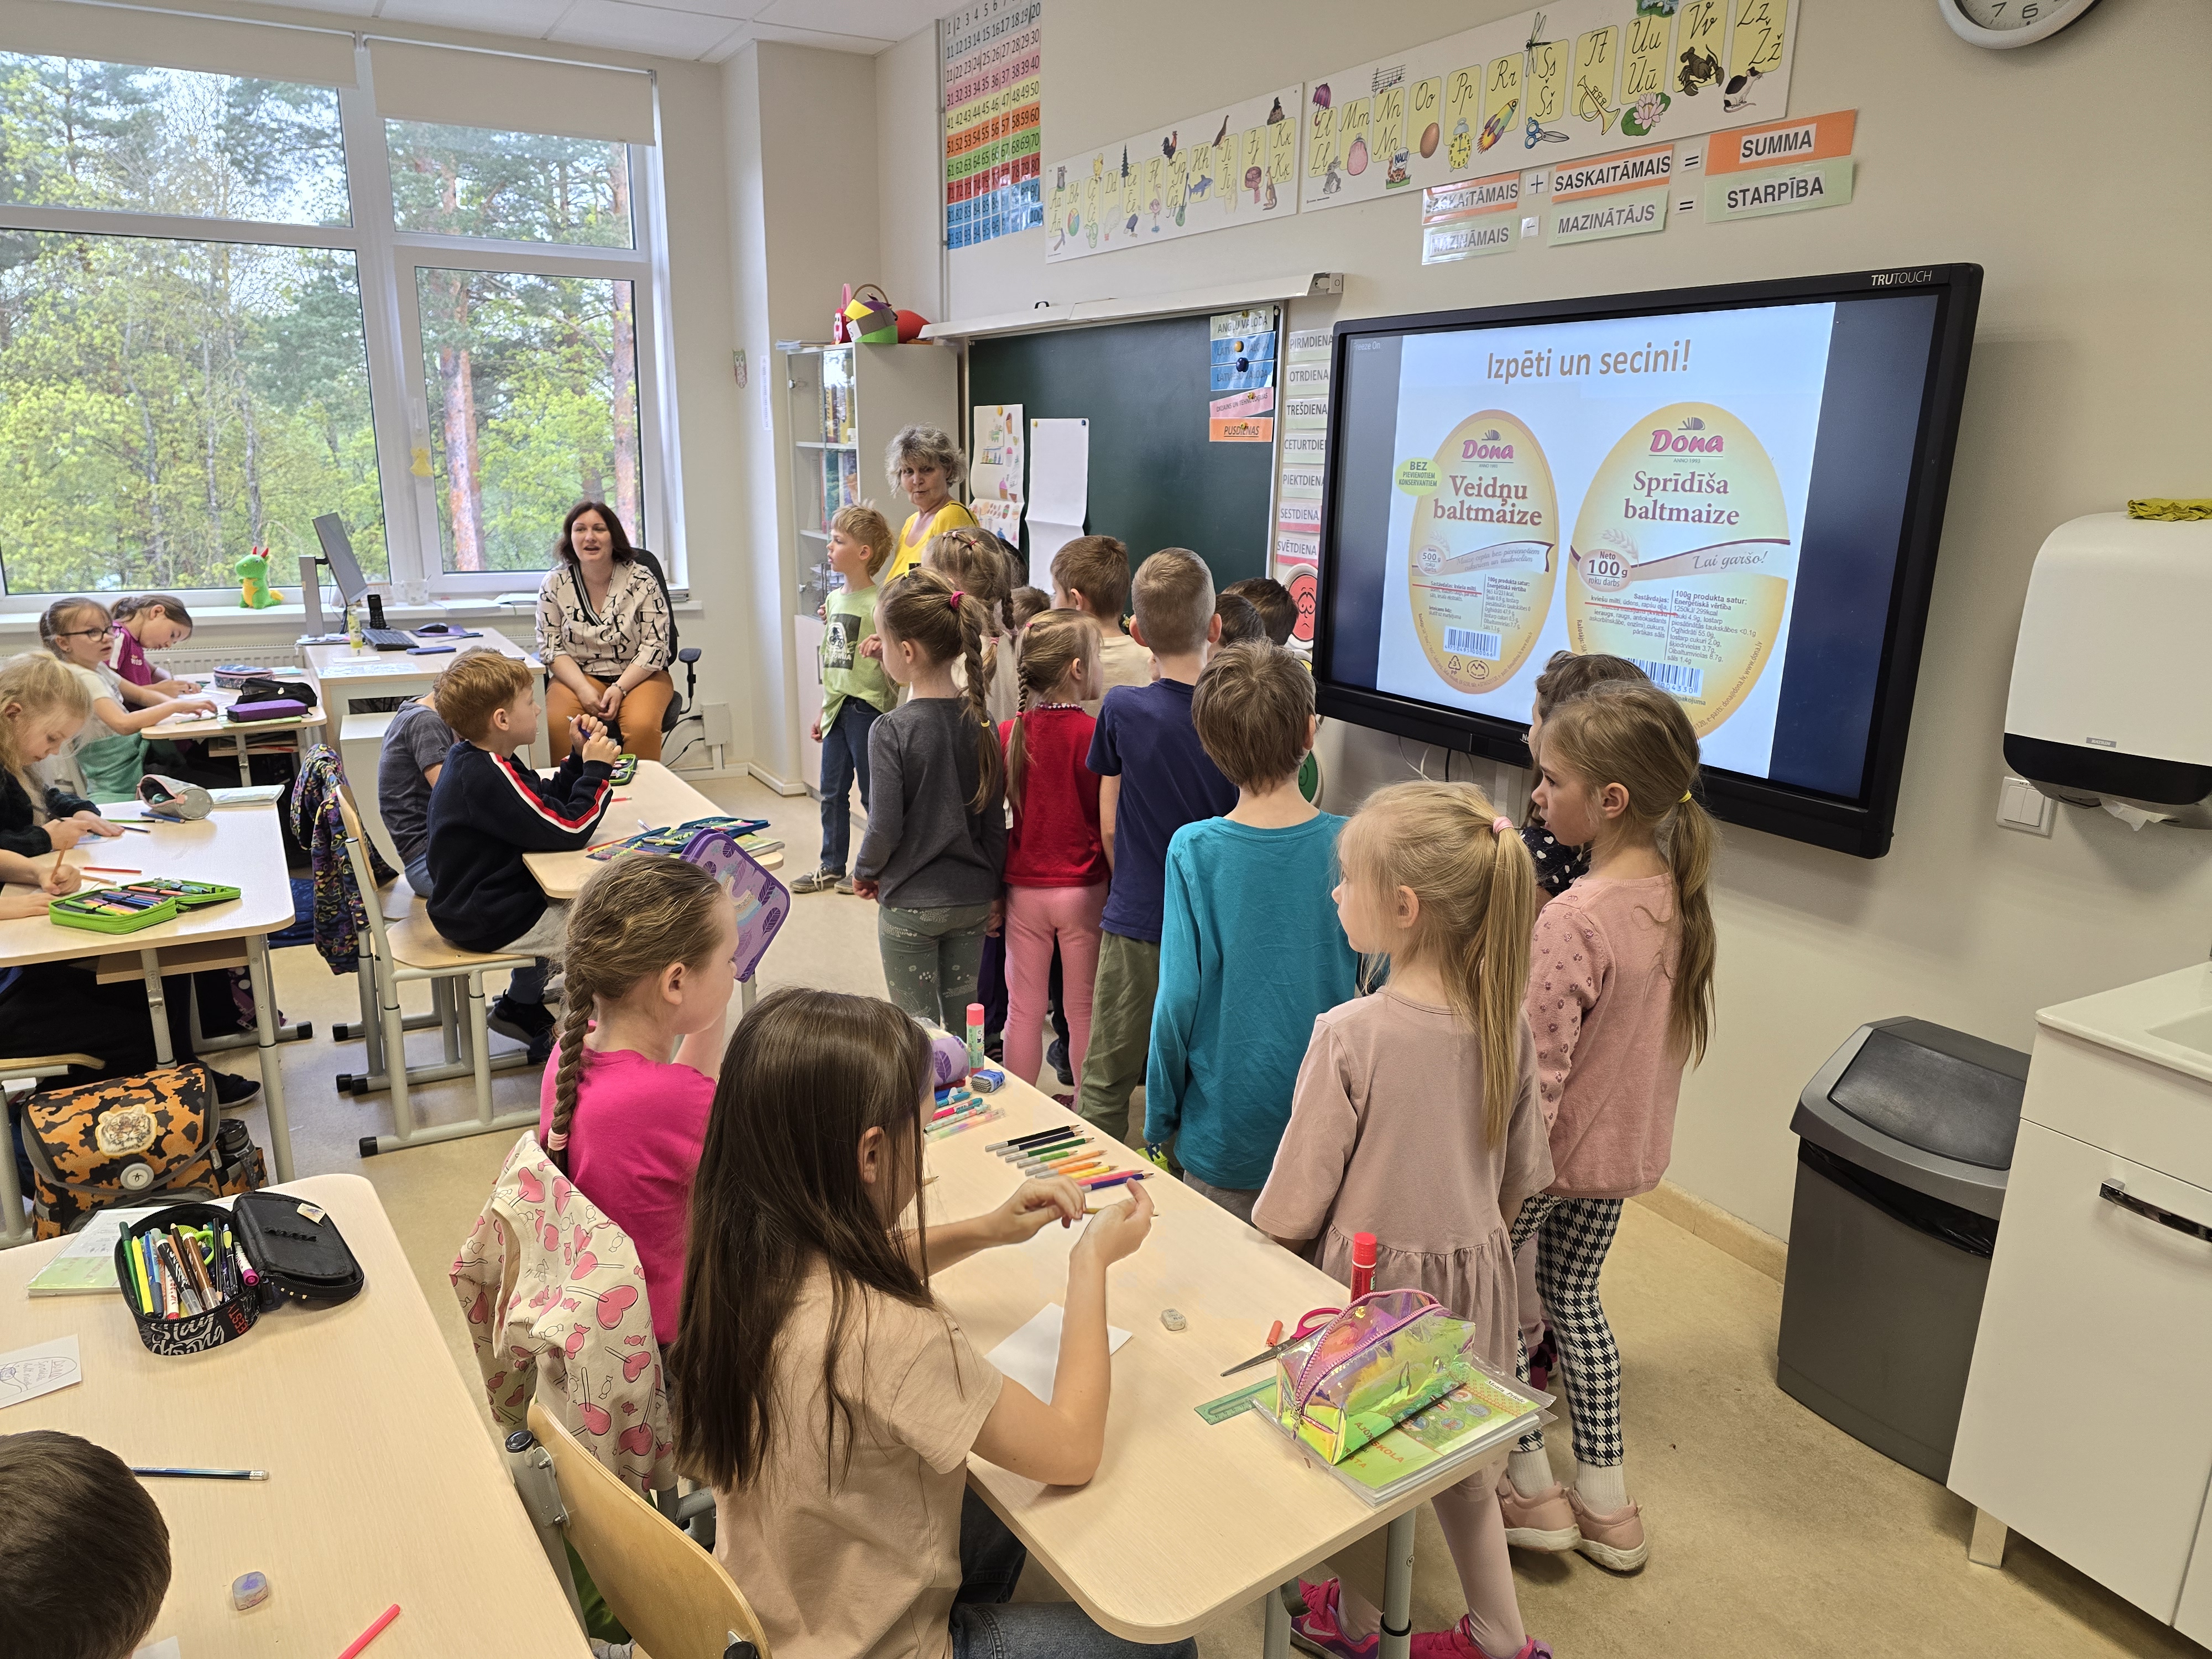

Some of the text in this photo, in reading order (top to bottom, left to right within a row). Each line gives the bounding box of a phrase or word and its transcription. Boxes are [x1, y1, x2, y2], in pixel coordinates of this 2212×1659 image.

[1000, 2, 1041, 32] 17 18 19 20
[1991, 2, 2038, 19] 7 6
[947, 55, 1040, 106] 31 32 33 34 35 36 37 38 39 40
[947, 107, 1040, 154] 51 52 53 54 55 56 57 58 59 60
[1554, 155, 1671, 192] SASKAITĀMAIS
[1741, 130, 1812, 158] SUMMA
[1557, 204, 1656, 234] MAZINĀTĀJS
[1727, 176, 1824, 209] STARPĪBA
[1871, 270, 1932, 286] TRUTOUCH
[1488, 339, 1691, 384] Izpēti un secini!
[1290, 369, 1329, 382] OTRDIENA
[1287, 401, 1328, 415] TREŠDIENA
[1462, 439, 1514, 460] Dona
[1650, 429, 1724, 453] Dona
[1410, 461, 1427, 471] BEZ
[1449, 474, 1528, 507] Veidņu
[1634, 471, 1729, 497] Sprīdīša
[1280, 508, 1319, 520] SESTDIENA
[1433, 498, 1542, 526] baltmaize
[1624, 498, 1739, 525] baltmaize
[1277, 540, 1317, 556] SVĒTDIENA
[1422, 552, 1437, 561] 500
[1600, 551, 1616, 560] Neto
[1588, 559, 1620, 576] 100
[1692, 551, 1768, 570] Lai garšo!
[1588, 576, 1620, 587] roku darbs
[1676, 590, 1747, 605] 100g produkta satur:
[1745, 641, 1763, 676] www.dona.lv
[1486, 1380, 1505, 1392] Monta
